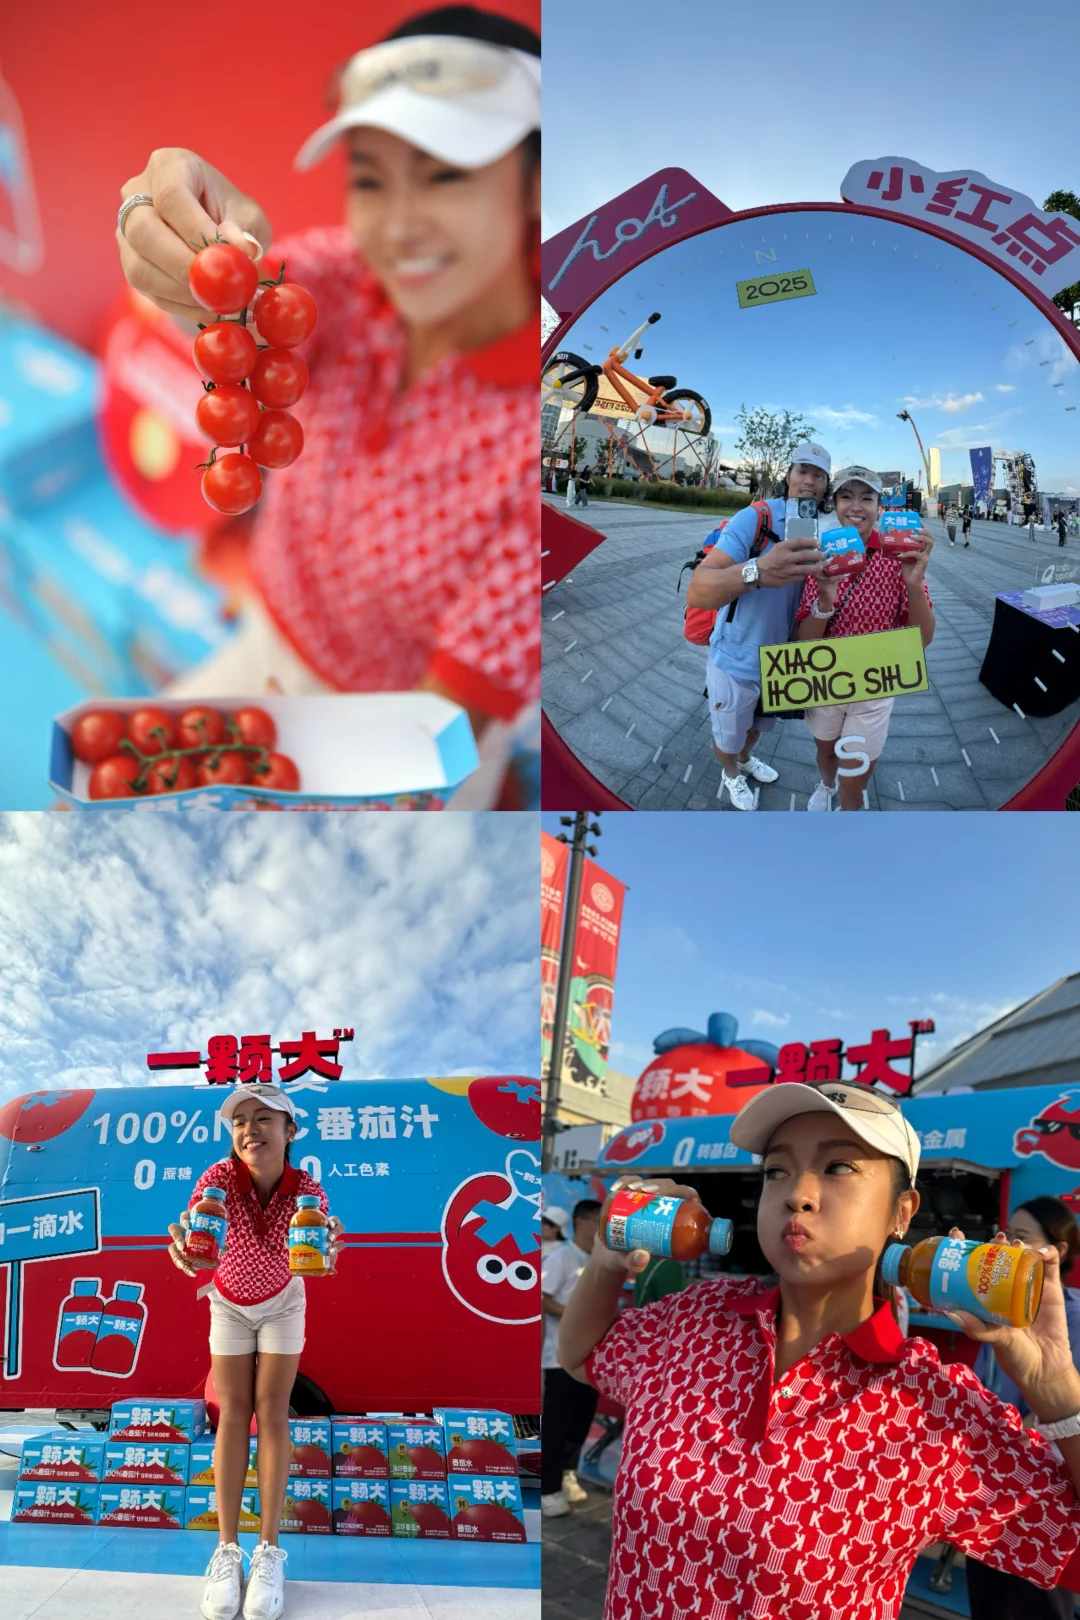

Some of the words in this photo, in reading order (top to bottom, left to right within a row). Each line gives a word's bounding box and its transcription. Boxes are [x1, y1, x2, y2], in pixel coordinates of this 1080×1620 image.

[866, 167, 1080, 275] 小红点
[754, 247, 778, 266] N
[746, 276, 808, 301] 2025
[766, 646, 837, 676] XIAO
[768, 671, 856, 706] HONG
[865, 661, 922, 695] SHU
[834, 735, 871, 777] S
[147, 1031, 343, 1085] 一颗大
[726, 1028, 914, 1093] 一颗大
[636, 1068, 713, 1103] 颗大
[92, 1104, 440, 1146] 100%NC番茄汁
[920, 1128, 967, 1150] 金属
[672, 1137, 695, 1167] 0
[697, 1142, 739, 1160] 转基因
[134, 1159, 156, 1190] 0
[162, 1166, 193, 1181] 蔗糖
[299, 1155, 322, 1183] 0
[327, 1162, 390, 1179] 人工色素
[0, 1210, 84, 1246] 一滴水
[65, 1315, 100, 1326] 一颗大
[104, 1319, 138, 1332] 一颗大
[113, 1407, 171, 1426] 一颗大
[448, 1417, 509, 1436] 一颗大
[290, 1427, 327, 1443] 颗大
[335, 1427, 384, 1444] 一颗大
[390, 1428, 440, 1444] 一颗大
[24, 1445, 82, 1465] 一颗大
[106, 1447, 166, 1467] 一颗大
[18, 1485, 77, 1507] 一颗大
[101, 1489, 162, 1510] 一颗大
[335, 1482, 386, 1499] 一颗大
[393, 1484, 445, 1501] 一颗大
[453, 1480, 517, 1501] 一颗大
